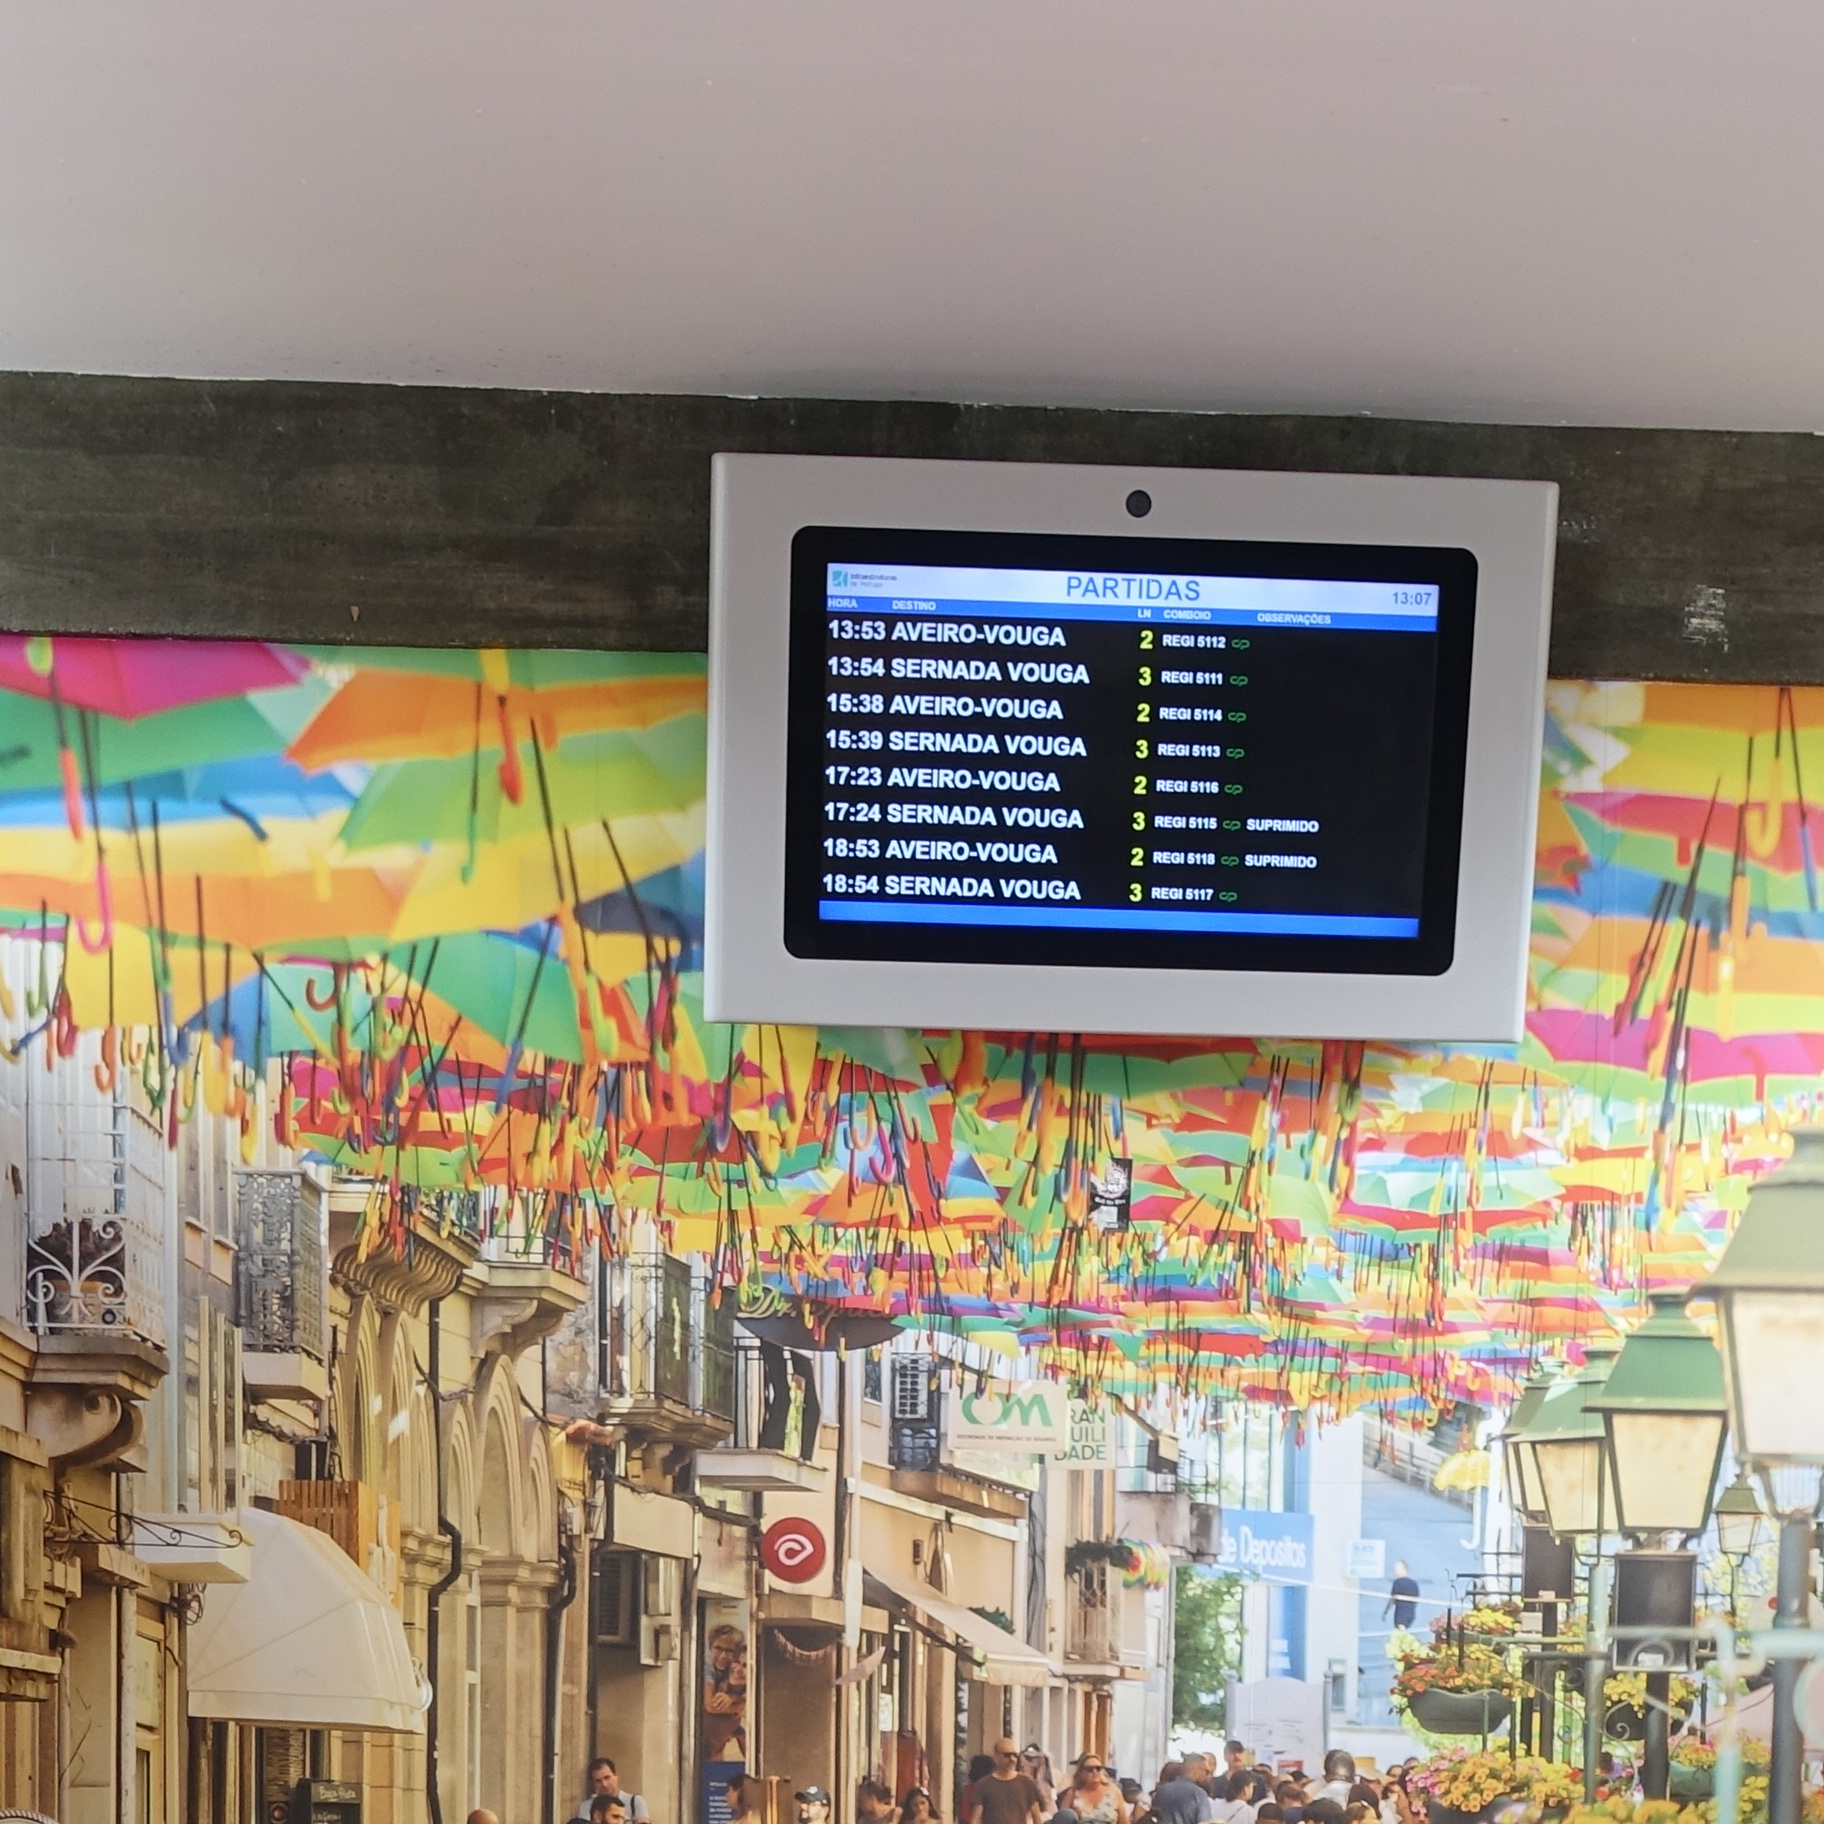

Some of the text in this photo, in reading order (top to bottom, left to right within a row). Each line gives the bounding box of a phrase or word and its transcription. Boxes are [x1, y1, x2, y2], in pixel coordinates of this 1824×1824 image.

[827, 597, 858, 609] HORA
[1066, 576, 1200, 602] PARTIDAS
[1392, 592, 1432, 606] 13:07
[892, 600, 936, 611] DESTINO
[1137, 608, 1152, 619] LN
[1163, 609, 1212, 621] COMBOIO
[1257, 612, 1332, 627] OBSERVAÇÕES
[828, 620, 1226, 650] 13:53 AVEIRO-VOUGA 2 REGI 5112
[827, 657, 1223, 686] 13:54 SERNADA VOUGA 3 REGI 5111
[827, 693, 1223, 723] 15:38 AVEIRO-VOUGA 2 REGI 5114
[826, 729, 1221, 759] 15:39 SERNADA VOUGA 3 REGI 5113
[825, 766, 1219, 795] 17:23 AVEIRO-VOUGA 2 REGI 5116
[824, 802, 1319, 833] 17:24 SERNADA VOUGA 3 REGI 5115 SUPRIMIDO
[823, 838, 1317, 868] 18:53 AVEIRO-VOUGA 2 REGI 5118 SUPRIMIDO
[823, 873, 1214, 902] 18:54 SERNADA VOUGA 3 REGI 5117
